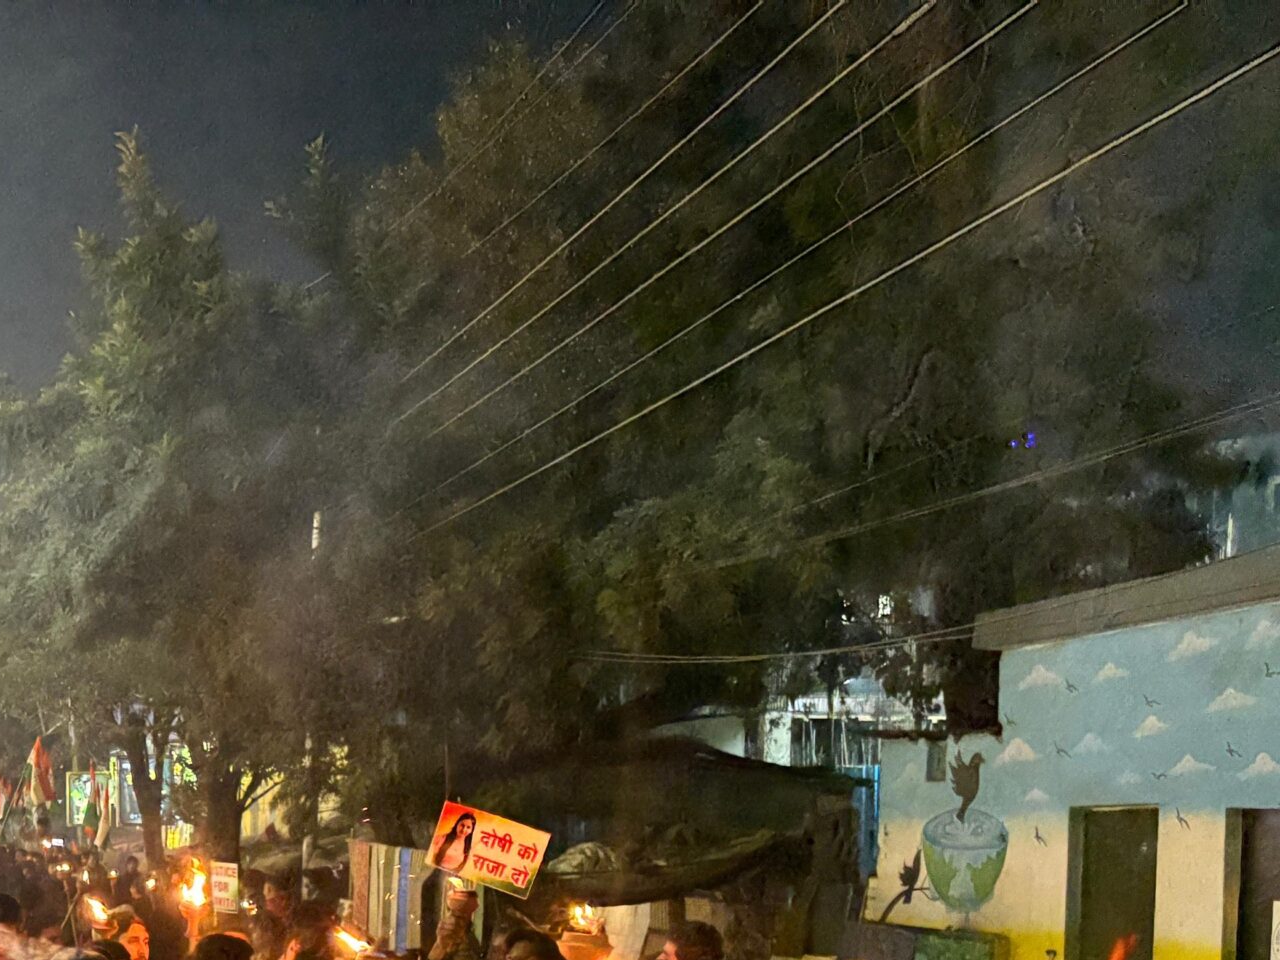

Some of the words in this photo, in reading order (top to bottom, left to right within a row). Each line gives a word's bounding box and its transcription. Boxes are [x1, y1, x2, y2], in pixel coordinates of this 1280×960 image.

[480, 828, 514, 854] दोषी
[517, 843, 539, 863] को
[510, 865, 530, 888] दो
